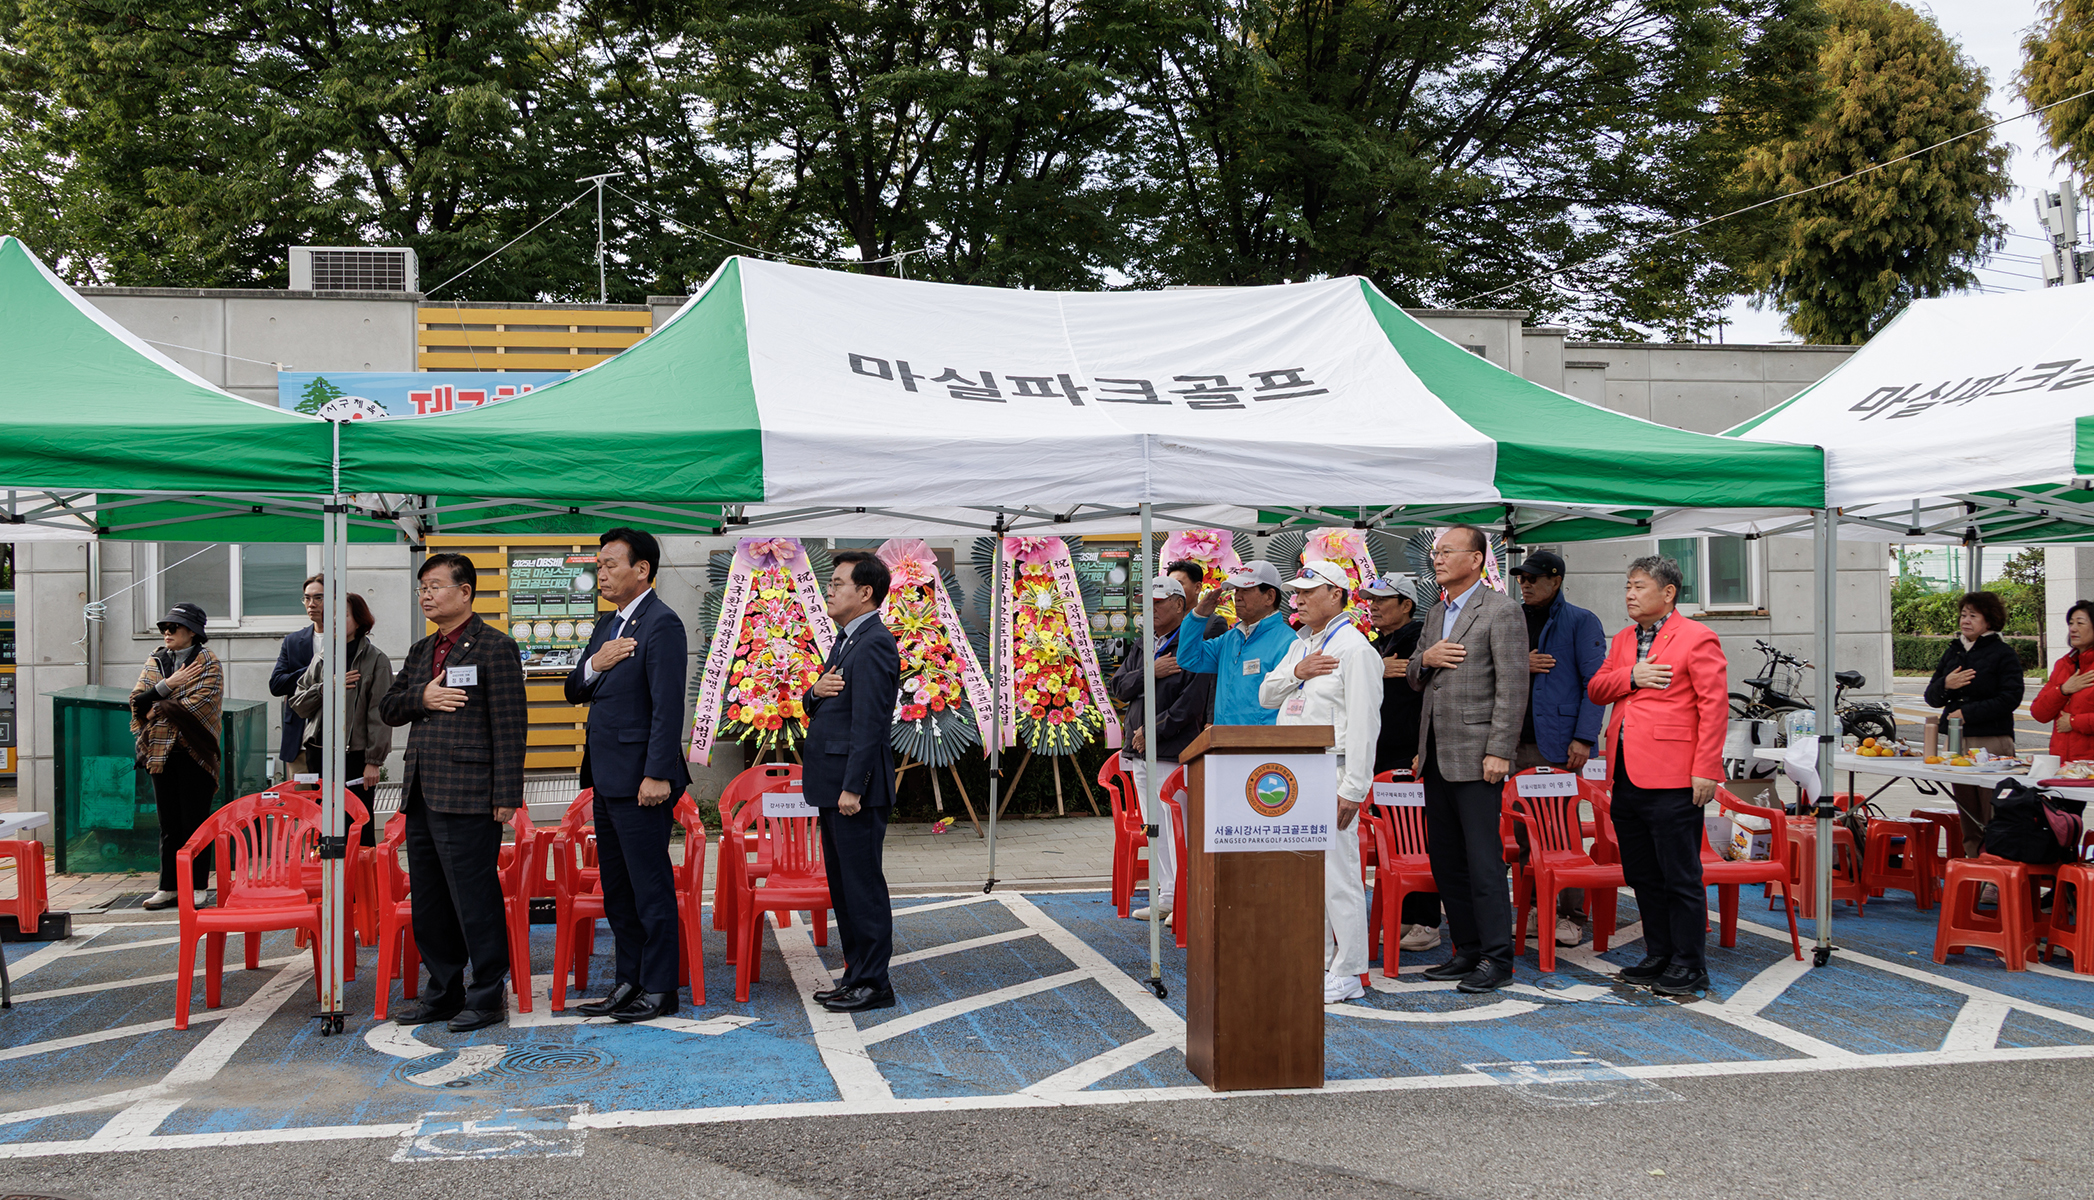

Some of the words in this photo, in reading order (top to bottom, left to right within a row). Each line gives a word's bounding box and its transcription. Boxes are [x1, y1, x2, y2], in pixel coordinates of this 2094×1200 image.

[848, 352, 1330, 410] 마실파크골프
[510, 568, 531, 578] 전국
[532, 568, 584, 578] 마실스크린
[1054, 558, 1069, 569] 祝
[510, 579, 571, 589] 파크골프대회
[797, 571, 813, 584] 祝
[1057, 573, 1075, 598] 제7회
[802, 585, 822, 614] 제7회
[705, 573, 747, 690] 한국환경체육청소년연맹
[703, 691, 715, 712] 이사장
[691, 714, 714, 750] 유범진
